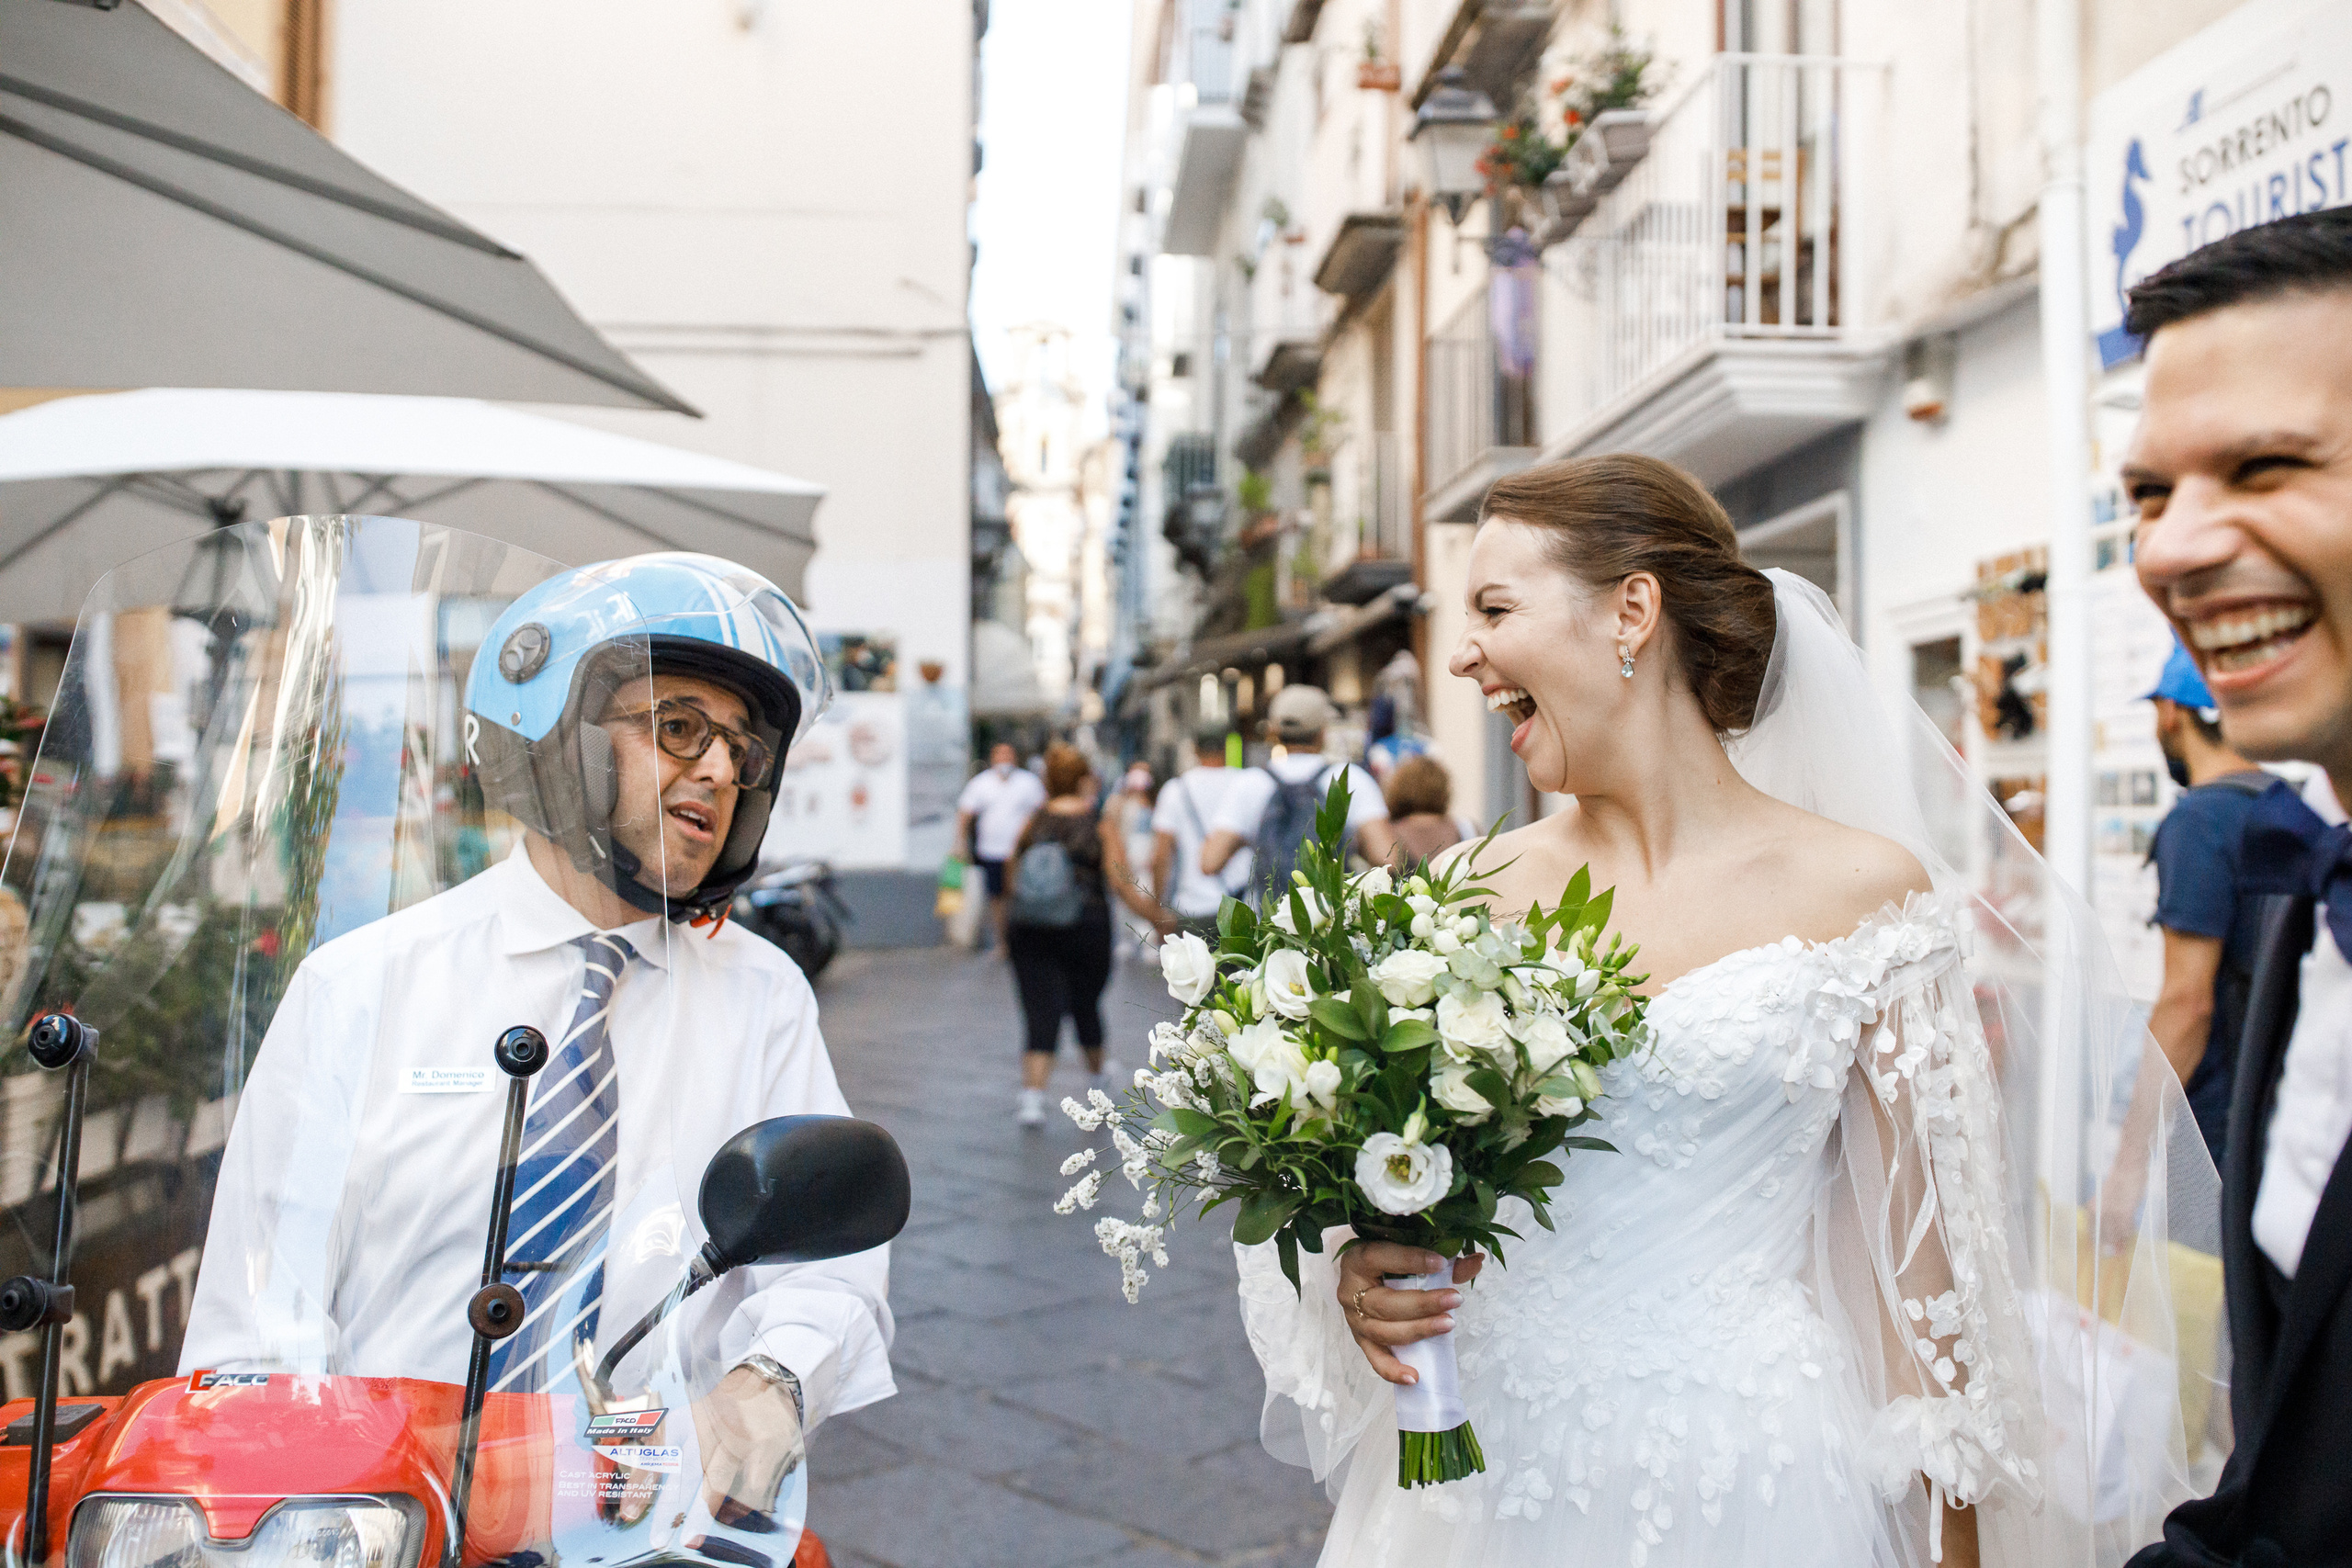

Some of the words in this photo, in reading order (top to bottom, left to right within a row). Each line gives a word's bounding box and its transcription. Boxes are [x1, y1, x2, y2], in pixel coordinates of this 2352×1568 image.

[2177, 84, 2332, 195] SORRENTO
[2181, 138, 2350, 256] TOURIST
[413, 1071, 428, 1079] Mr.
[432, 1070, 485, 1079] Domenico
[198, 1373, 270, 1386] FACO
